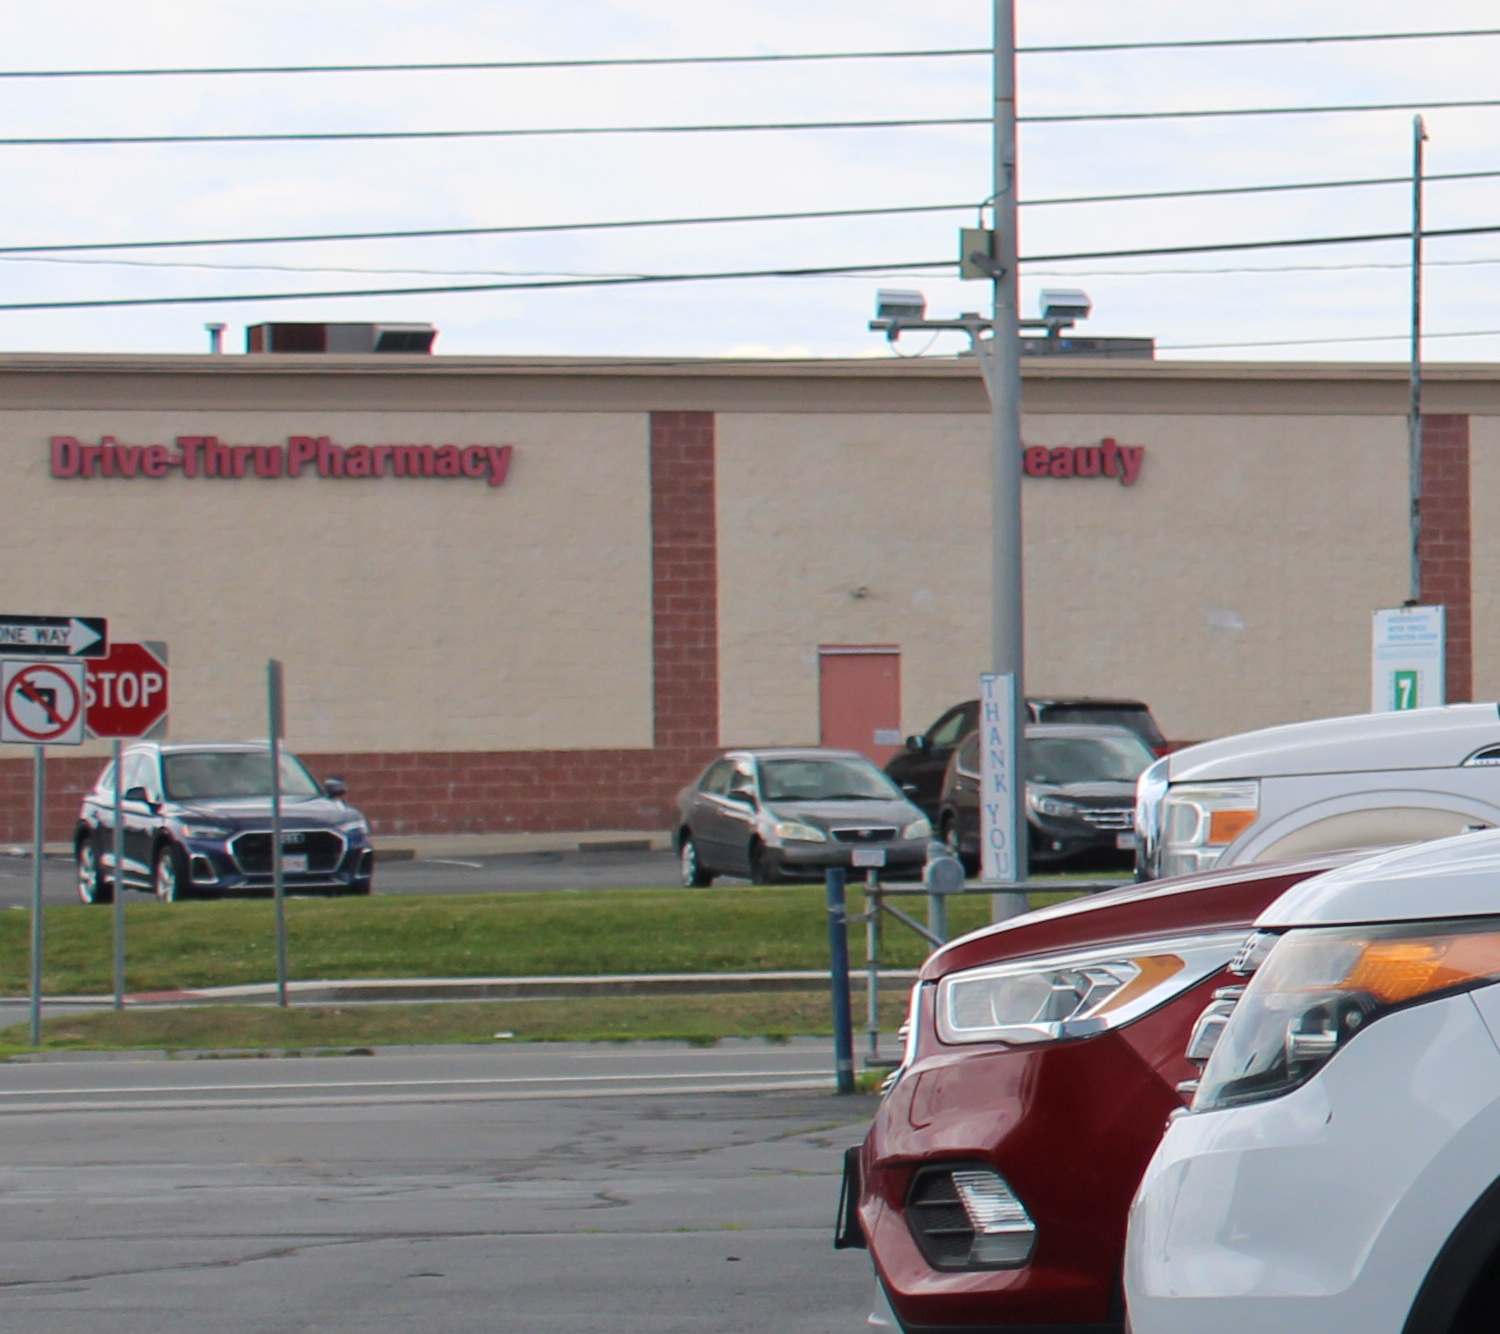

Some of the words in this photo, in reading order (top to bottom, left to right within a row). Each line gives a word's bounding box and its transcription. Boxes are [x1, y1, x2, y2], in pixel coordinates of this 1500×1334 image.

[50, 435, 282, 478] Drive-Thru
[287, 435, 513, 485] Pharmacy
[1021, 437, 1144, 486] eauty
[35, 628, 70, 644] WAY
[1398, 678, 1412, 709] 7
[981, 679, 1007, 793] THANK
[986, 804, 1009, 874] YOU
